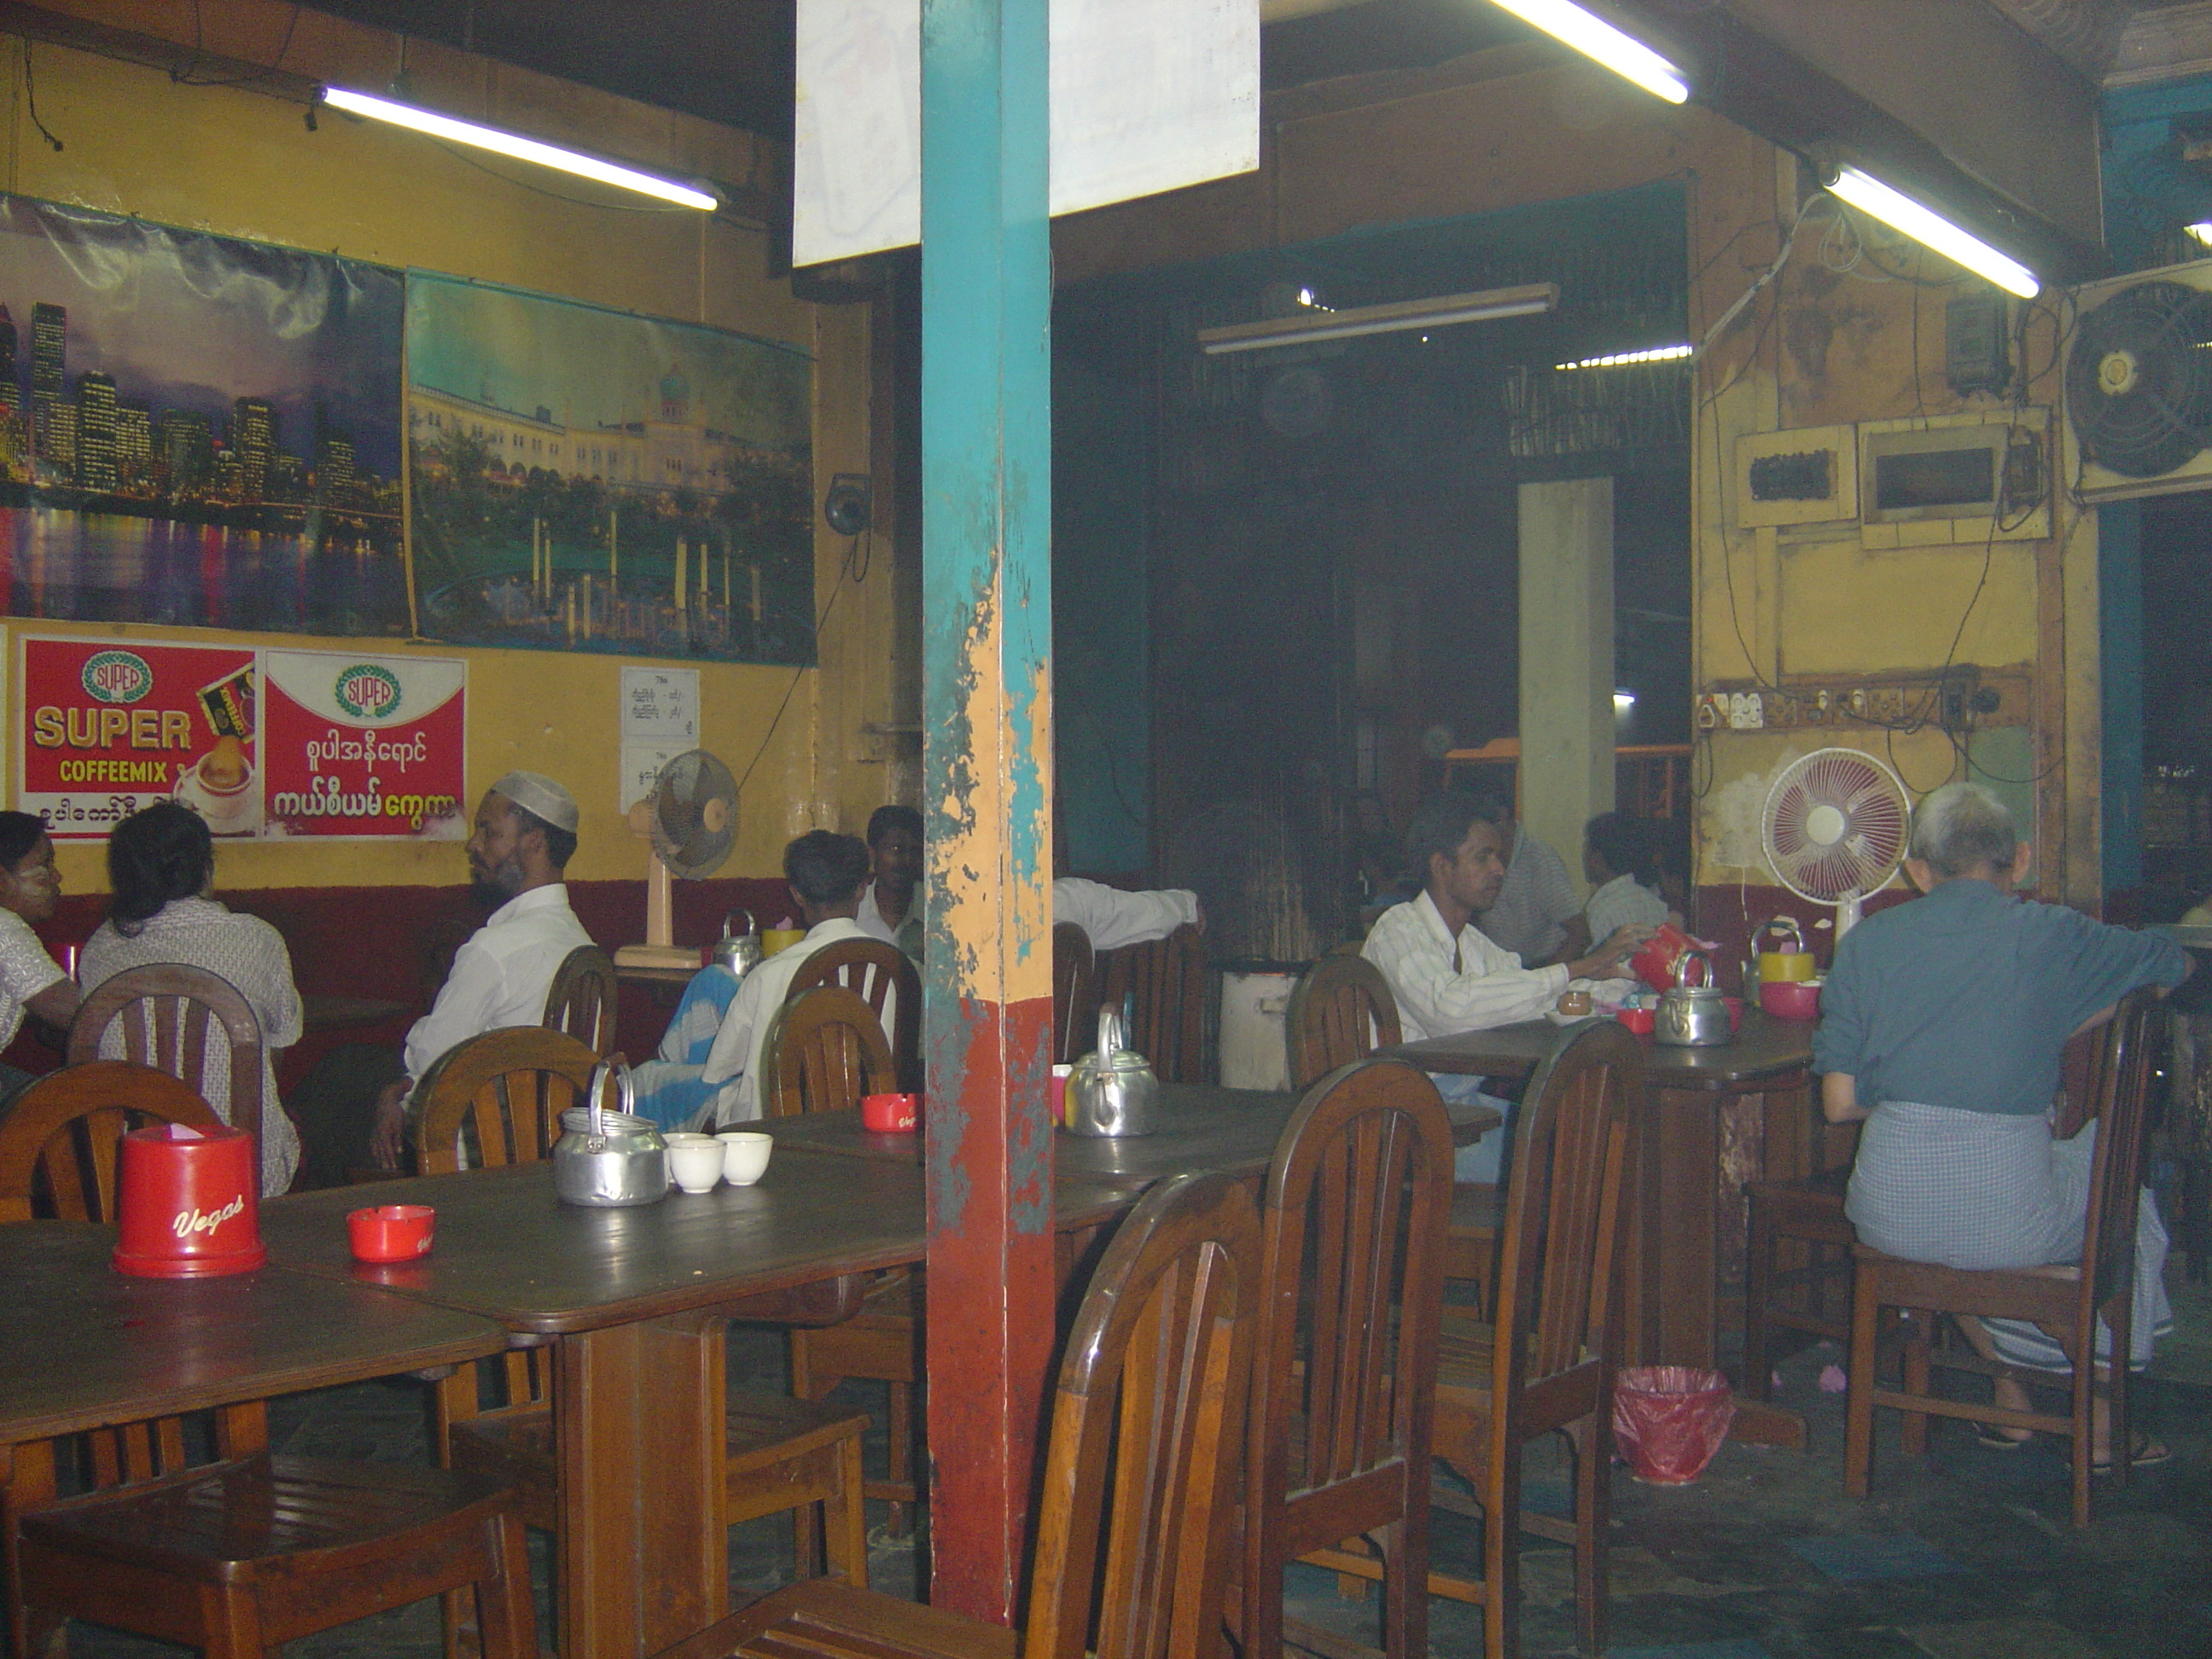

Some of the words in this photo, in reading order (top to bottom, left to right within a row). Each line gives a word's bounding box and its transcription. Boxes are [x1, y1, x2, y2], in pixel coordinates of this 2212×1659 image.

[96, 664, 140, 690] SUPER
[347, 676, 392, 707] SUPER
[34, 706, 191, 751] SUPER
[60, 760, 167, 783] COFFEEMIX
[172, 1194, 244, 1237] Vegas
